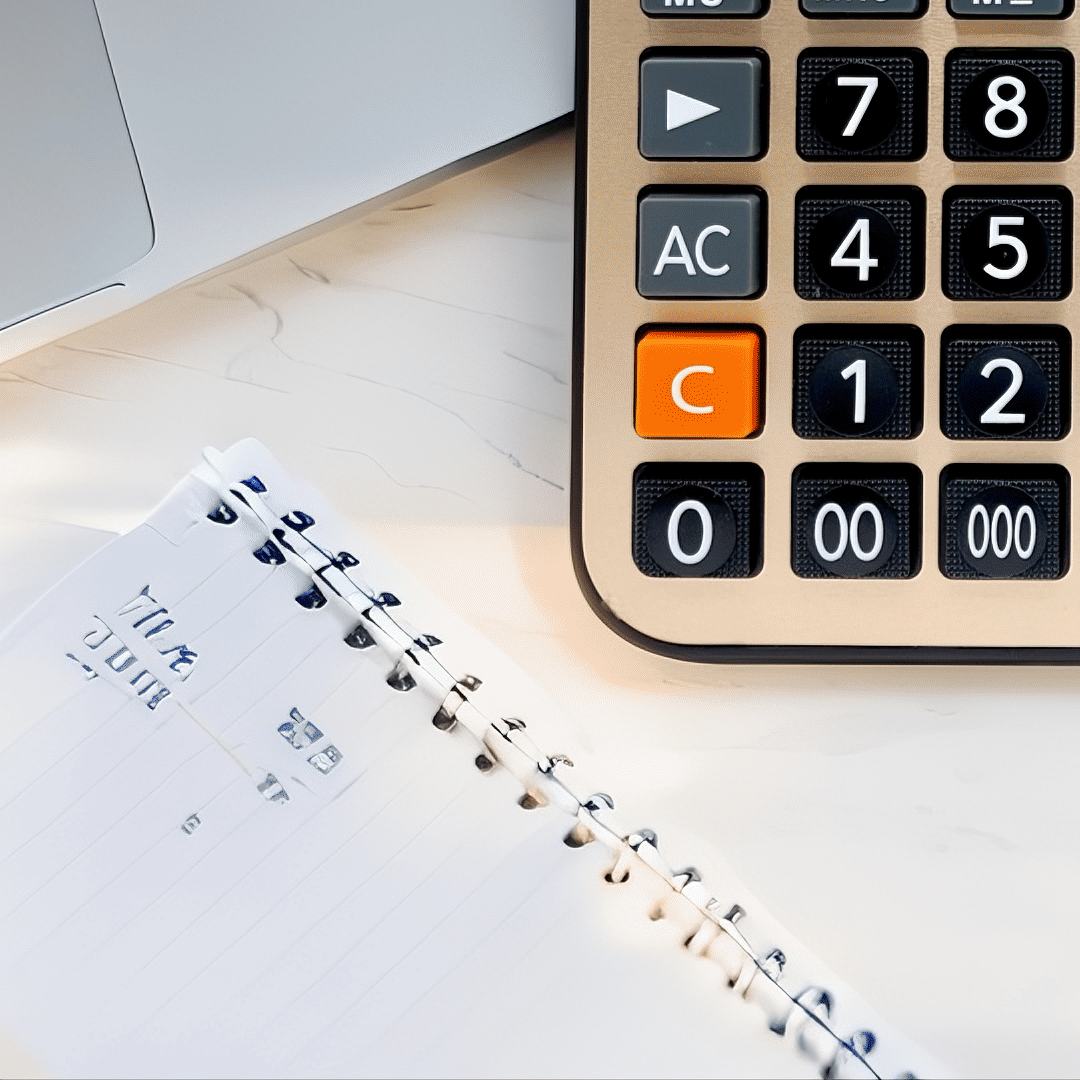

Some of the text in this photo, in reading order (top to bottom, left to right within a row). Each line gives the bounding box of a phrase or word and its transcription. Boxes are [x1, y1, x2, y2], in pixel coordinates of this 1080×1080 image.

[837, 76, 879, 137] 7
[984, 75, 1028, 138] 8
[653, 225, 731, 276] AC
[830, 218, 878, 281] 4
[983, 216, 1028, 280] 5
[671, 365, 714, 414] C
[840, 359, 867, 423] 1
[980, 358, 1026, 424] 2
[667, 499, 713, 565] 0
[814, 502, 884, 562] 00
[967, 504, 1036, 559] 000
